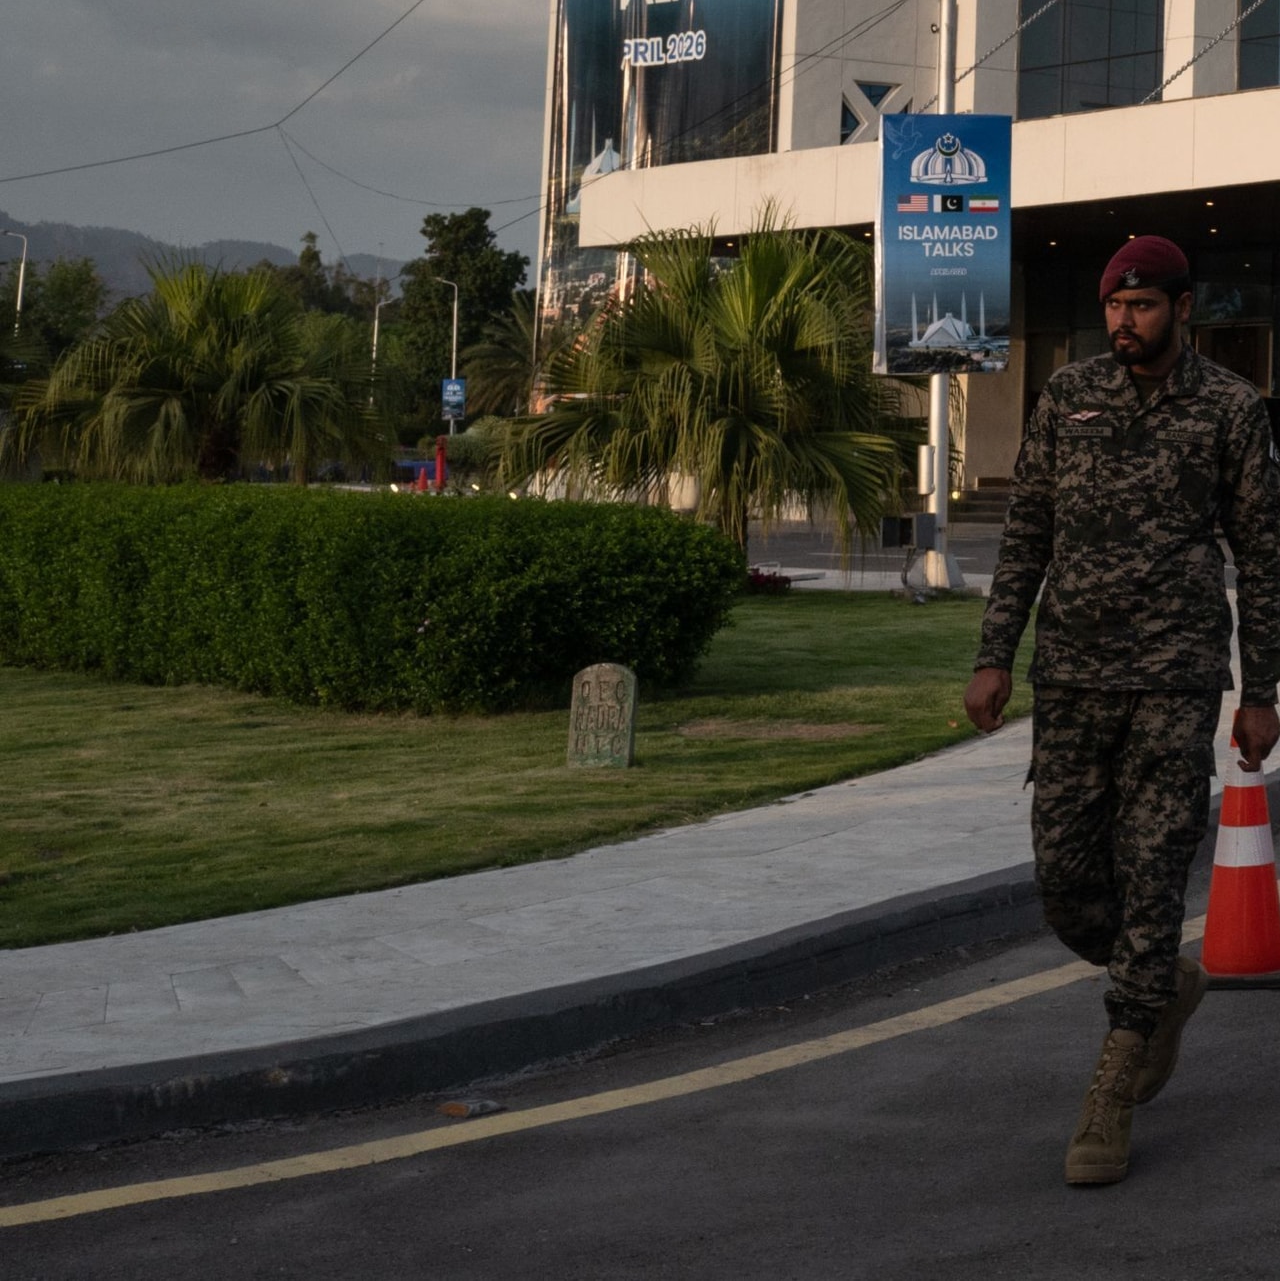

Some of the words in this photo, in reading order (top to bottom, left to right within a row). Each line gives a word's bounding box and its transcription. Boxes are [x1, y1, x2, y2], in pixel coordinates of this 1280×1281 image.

[620, 37, 665, 70] PRIL
[667, 30, 706, 63] 2026
[898, 225, 998, 240] ISLAMABAD
[921, 242, 974, 257] TALKS
